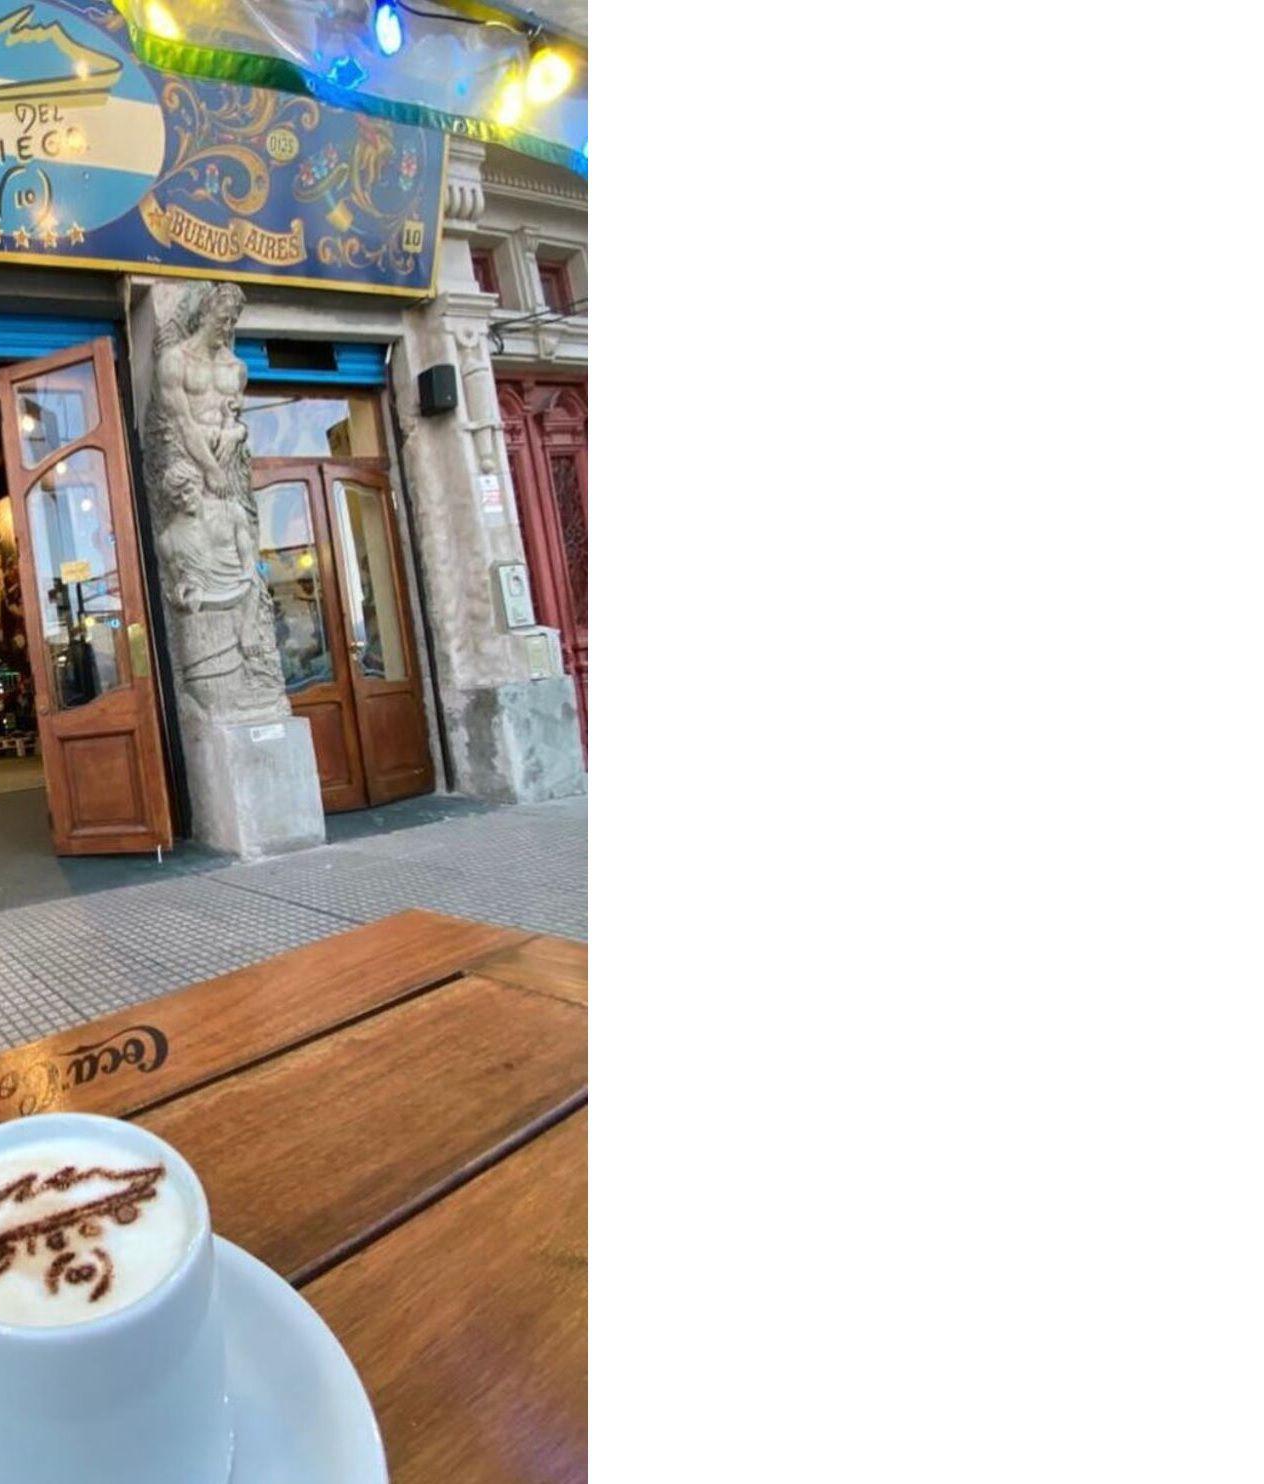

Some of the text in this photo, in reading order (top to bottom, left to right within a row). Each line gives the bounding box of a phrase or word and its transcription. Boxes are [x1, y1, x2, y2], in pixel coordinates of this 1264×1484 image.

[14, 102, 65, 135] DEL
[170, 210, 301, 260] BUENOS AIRES
[405, 228, 422, 247] 10
